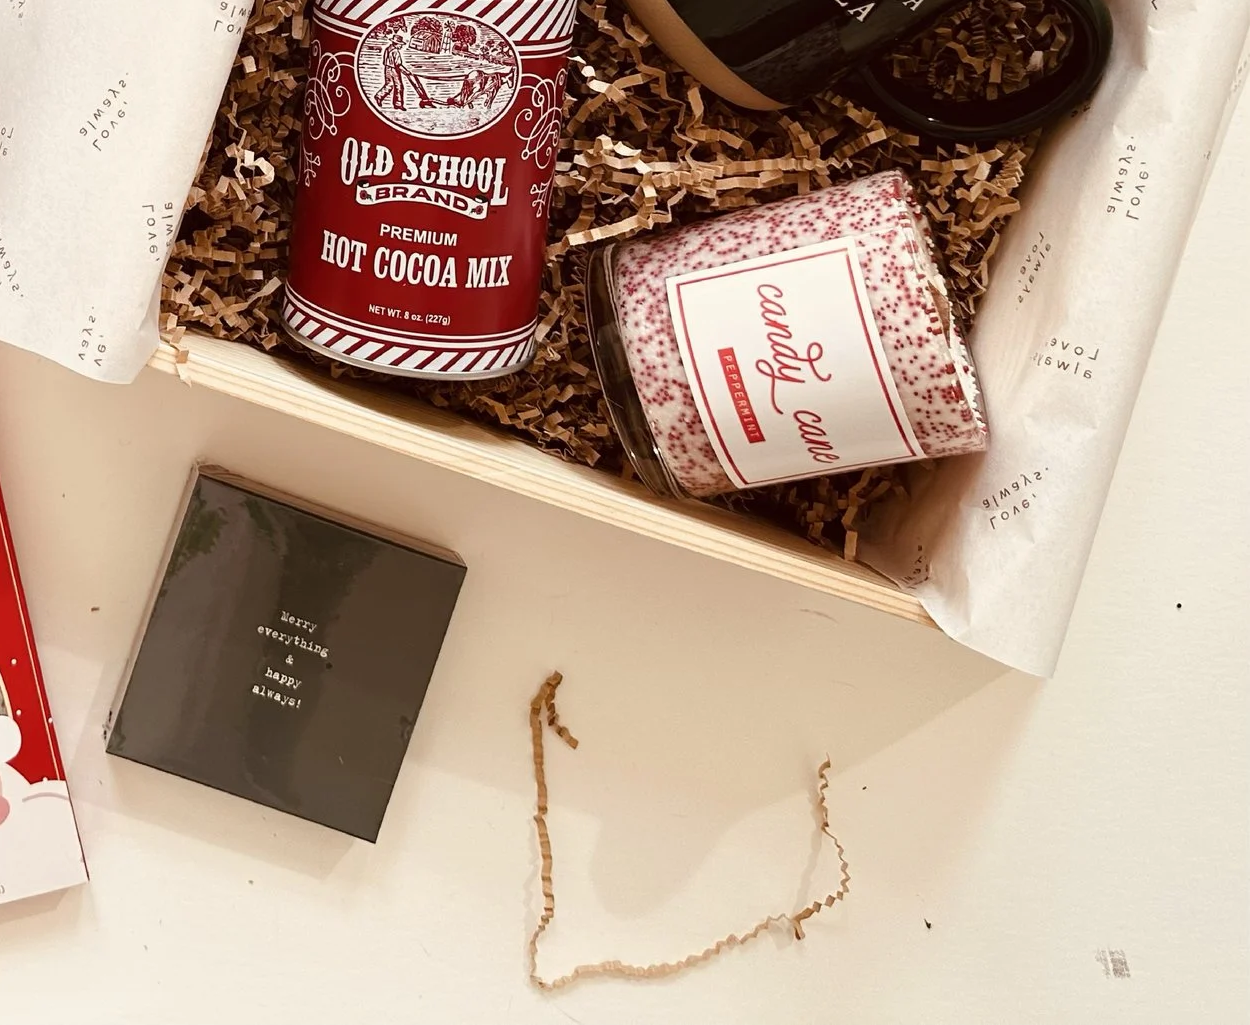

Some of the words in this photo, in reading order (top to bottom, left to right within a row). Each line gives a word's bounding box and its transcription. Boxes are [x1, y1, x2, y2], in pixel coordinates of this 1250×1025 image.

[340, 136, 395, 186] OLD
[401, 150, 509, 207] SCHOOL
[375, 186, 469, 212] BRAND
[379, 223, 458, 247] PREMIUM
[320, 229, 367, 274] HOT
[373, 247, 458, 289] COCOA
[465, 255, 513, 289] MIX
[368, 304, 386, 318] NET
[387, 307, 403, 320] WT.
[404, 311, 410, 321] 8
[425, 315, 451, 327] (227g)
[755, 284, 832, 415] candy
[722, 354, 760, 439] PEPPERMINT
[793, 409, 841, 464] cane
[280, 610, 318, 633] Merry
[257, 625, 330, 658] everything
[285, 654, 294, 665] &
[265, 667, 302, 690] happy
[252, 684, 302, 709] always!
